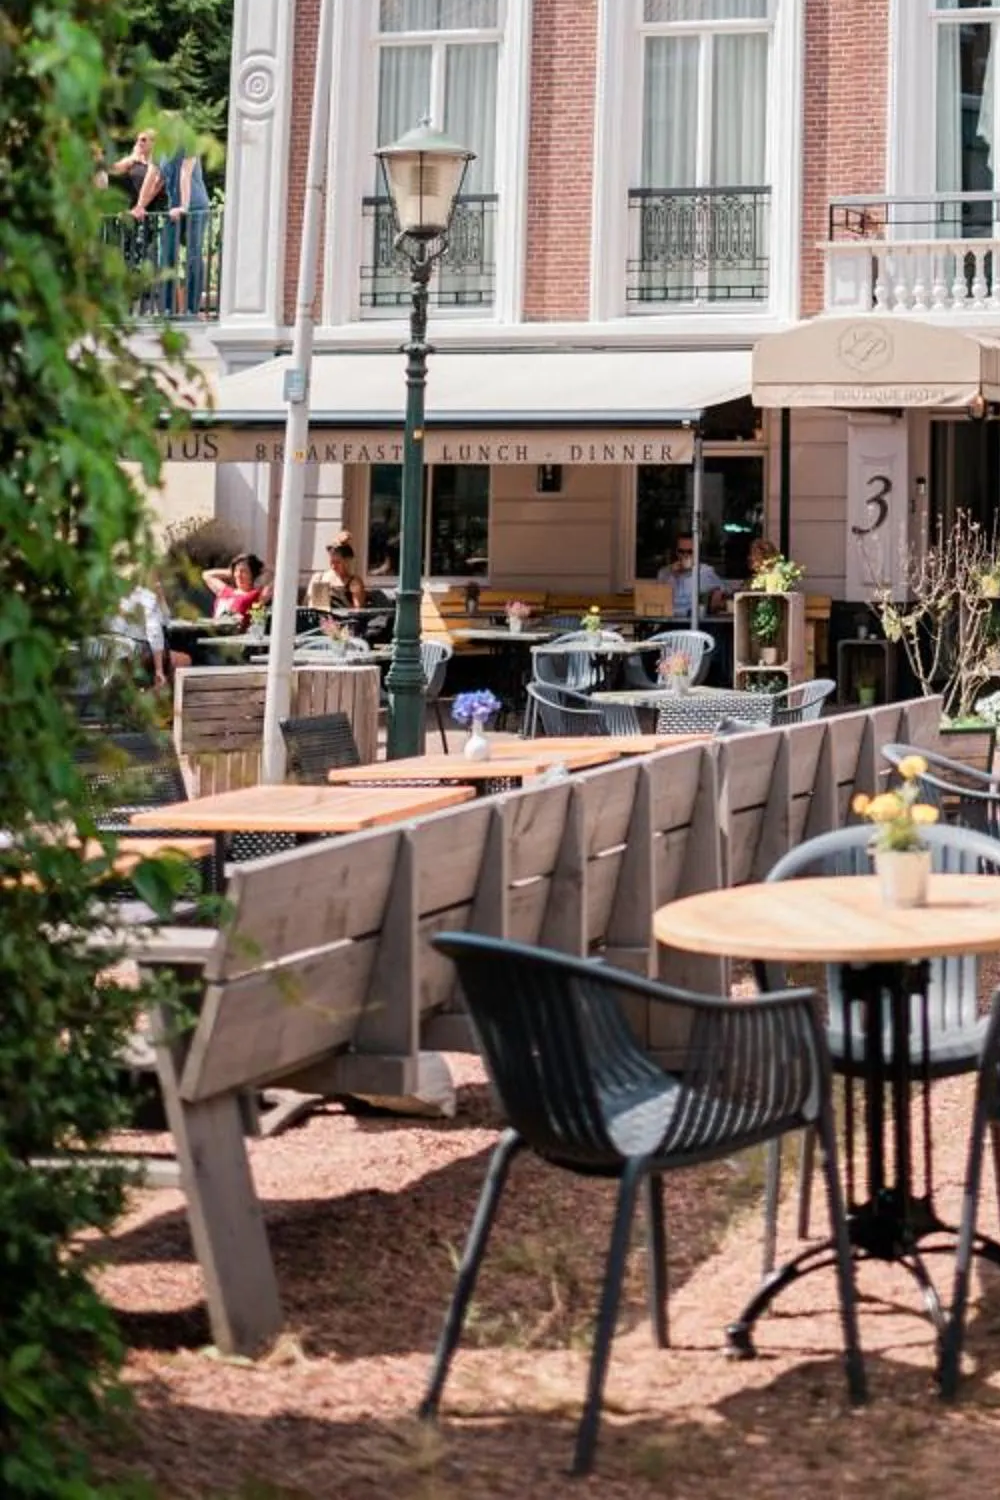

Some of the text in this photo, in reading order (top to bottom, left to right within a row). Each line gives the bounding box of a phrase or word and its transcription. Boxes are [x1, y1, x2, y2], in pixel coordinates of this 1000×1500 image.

[254, 443, 403, 461] BRAKFAST
[442, 443, 529, 461] LUNCH
[570, 443, 674, 461] DINNER
[851, 475, 893, 536] 3
